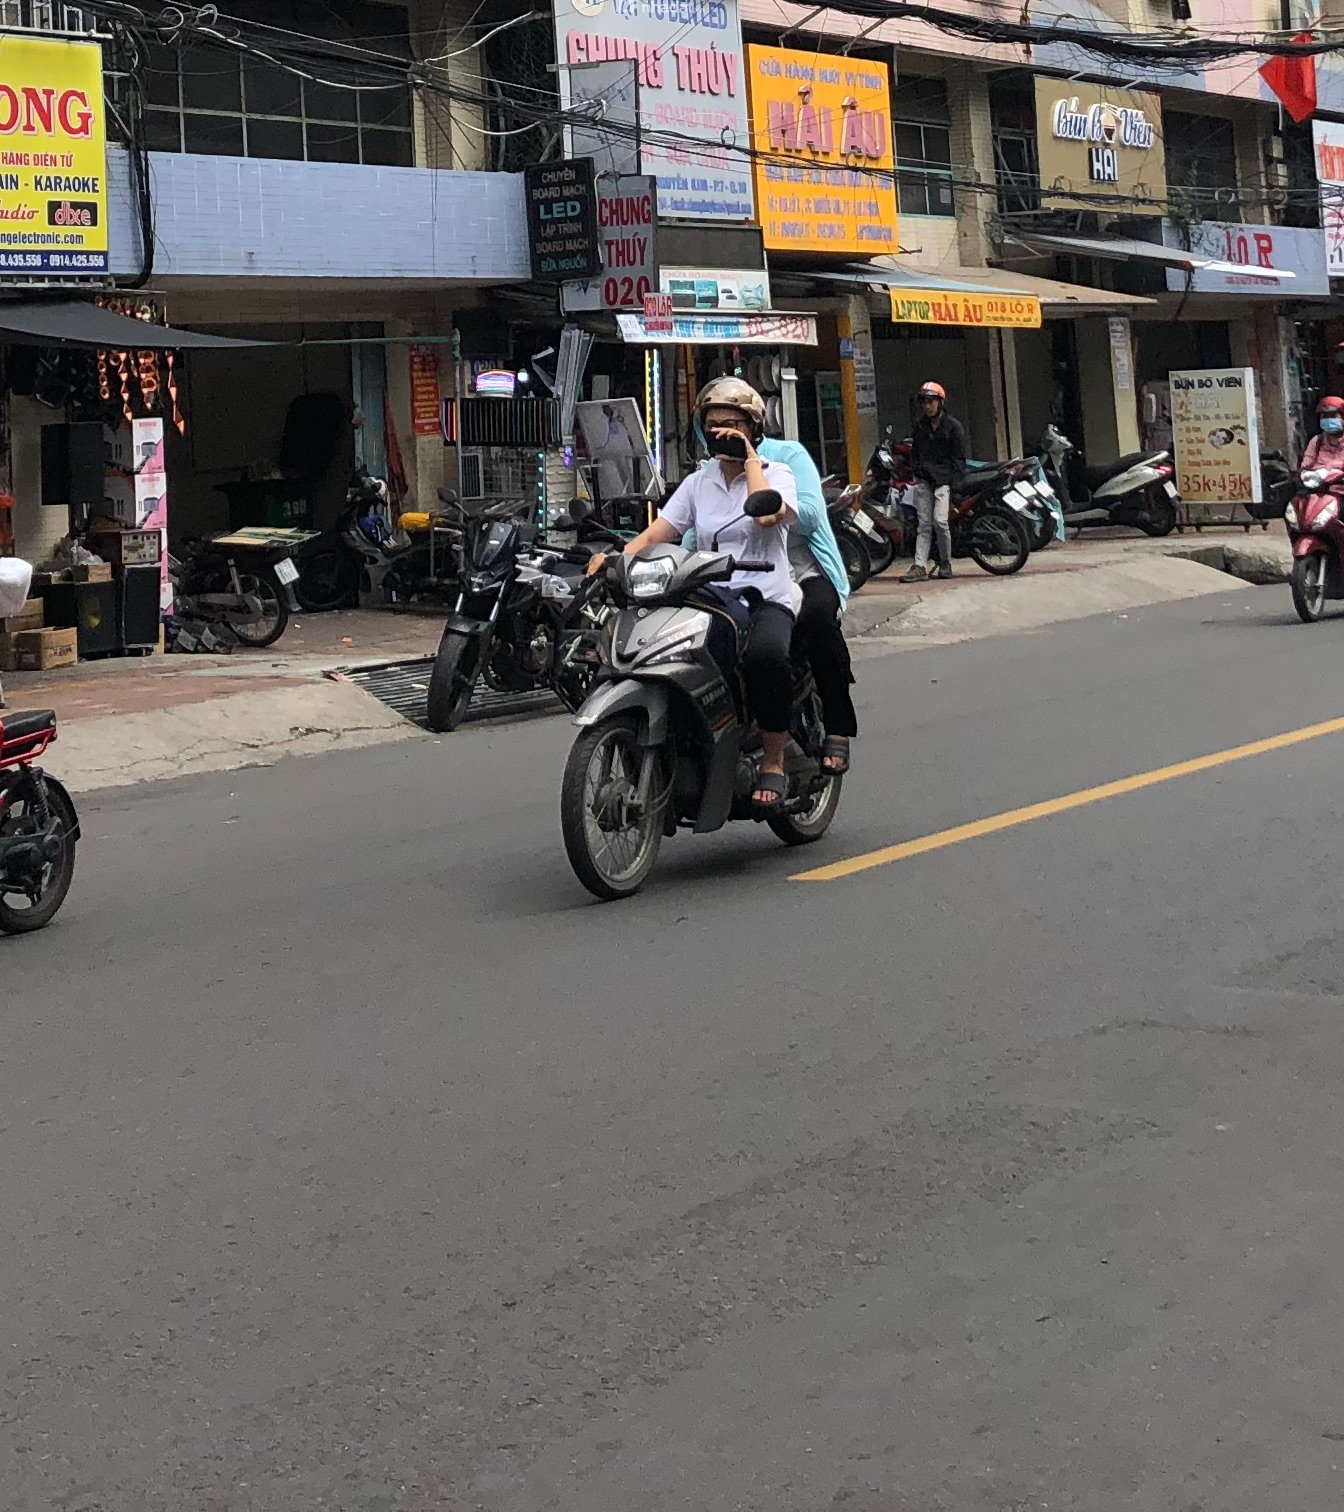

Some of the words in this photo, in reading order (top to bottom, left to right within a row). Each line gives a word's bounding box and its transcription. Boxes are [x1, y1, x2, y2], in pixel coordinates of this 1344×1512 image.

[701, 0, 728, 29] LED
[672, 41, 738, 97] THÚY
[767, 85, 833, 155] HẢI
[1, 148, 30, 167] HÀNG
[34, 174, 100, 194] KARAOKE
[539, 200, 582, 220] LED
[598, 195, 652, 227] CHUNG
[604, 232, 648, 268] THÚY
[1252, 232, 1275, 269] R
[604, 275, 652, 307] 020
[894, 299, 930, 321] LAPTOP
[931, 293, 960, 323] HẢI
[962, 297, 983, 323] ÂU
